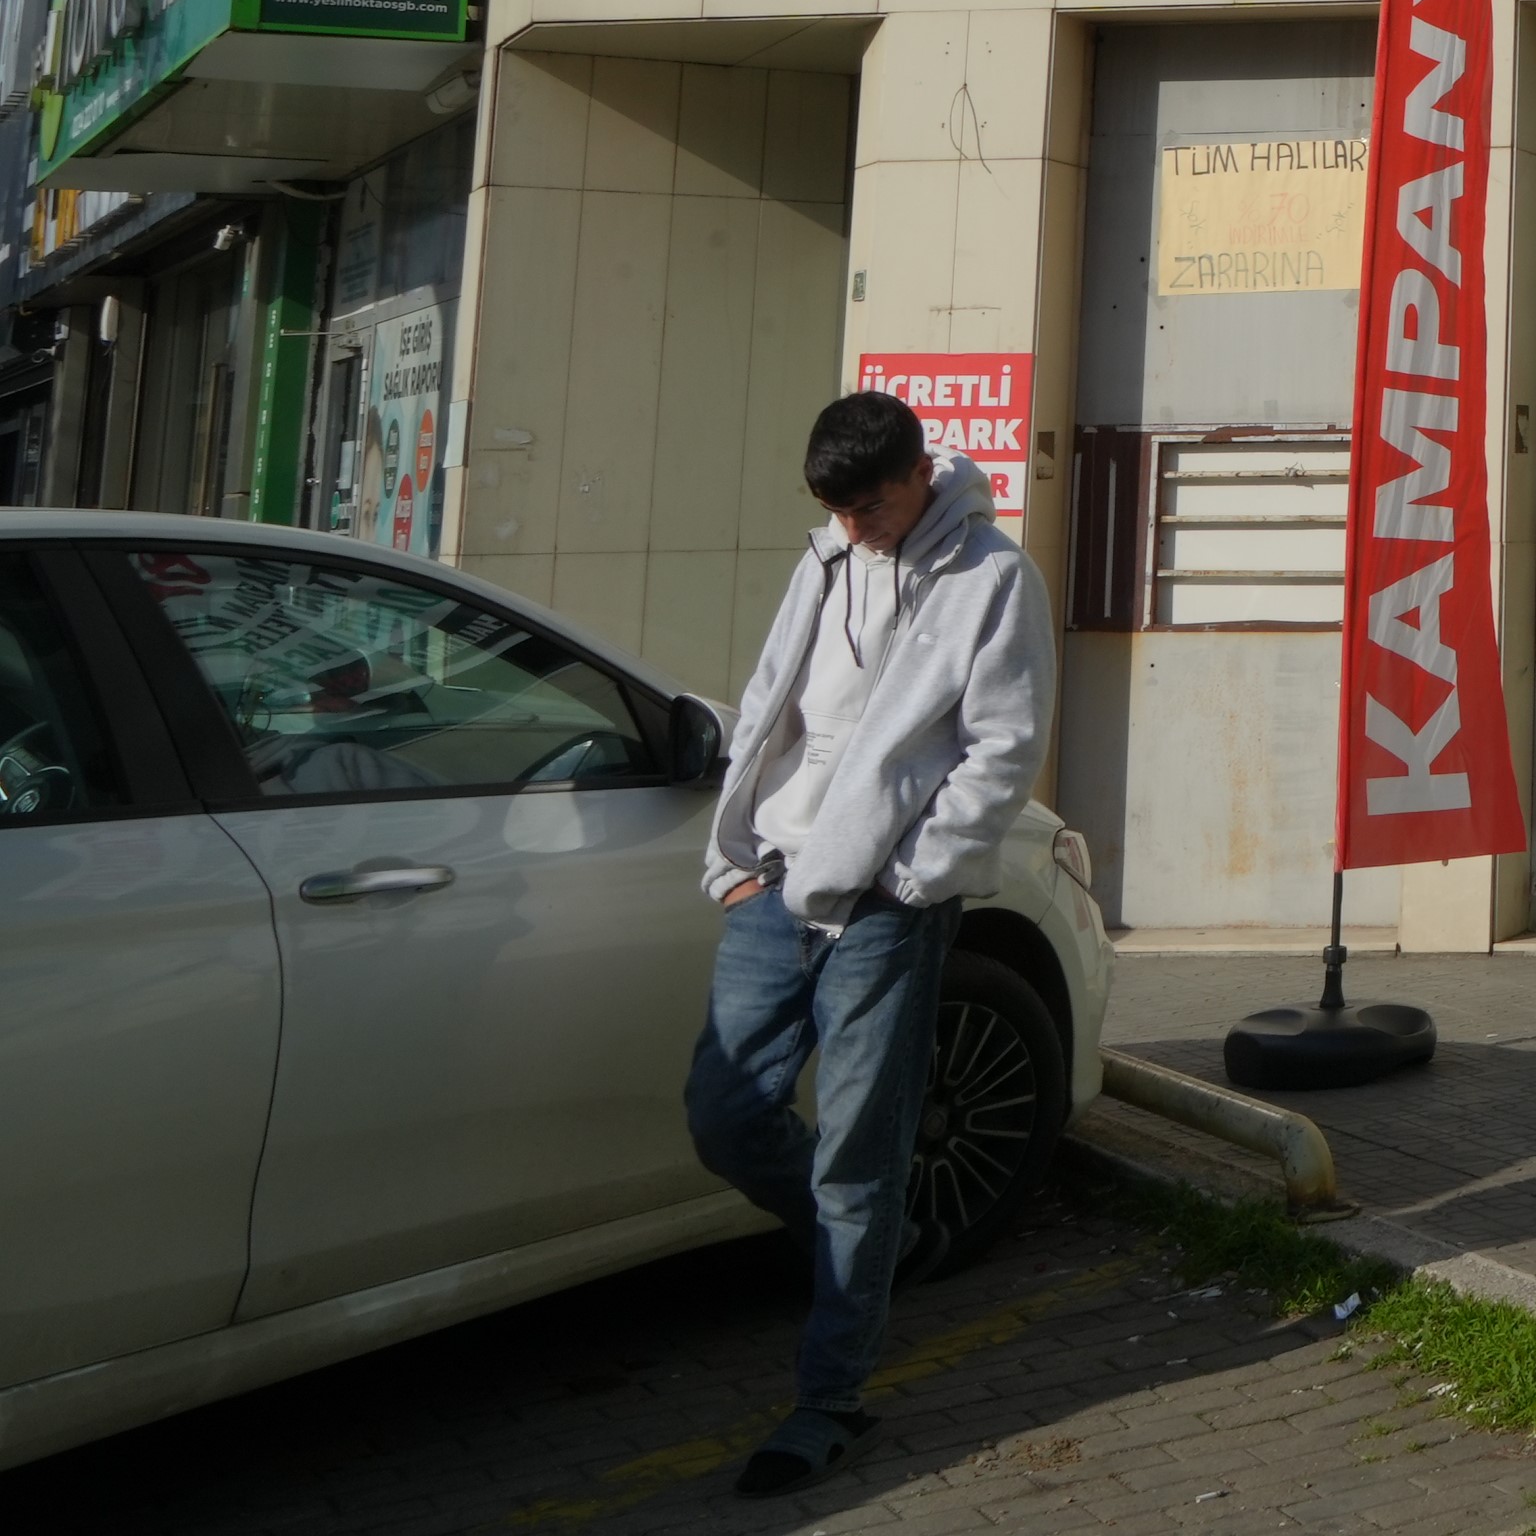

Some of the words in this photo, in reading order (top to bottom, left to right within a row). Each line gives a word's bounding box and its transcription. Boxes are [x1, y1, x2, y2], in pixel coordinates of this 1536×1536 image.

[1164, 145, 1239, 176] TÜM
[1250, 140, 1367, 173] HALILAR
[1169, 250, 1324, 289] ZARARINA
[862, 364, 1012, 407] ÜCRETLİ
[923, 418, 1023, 451] PARK
